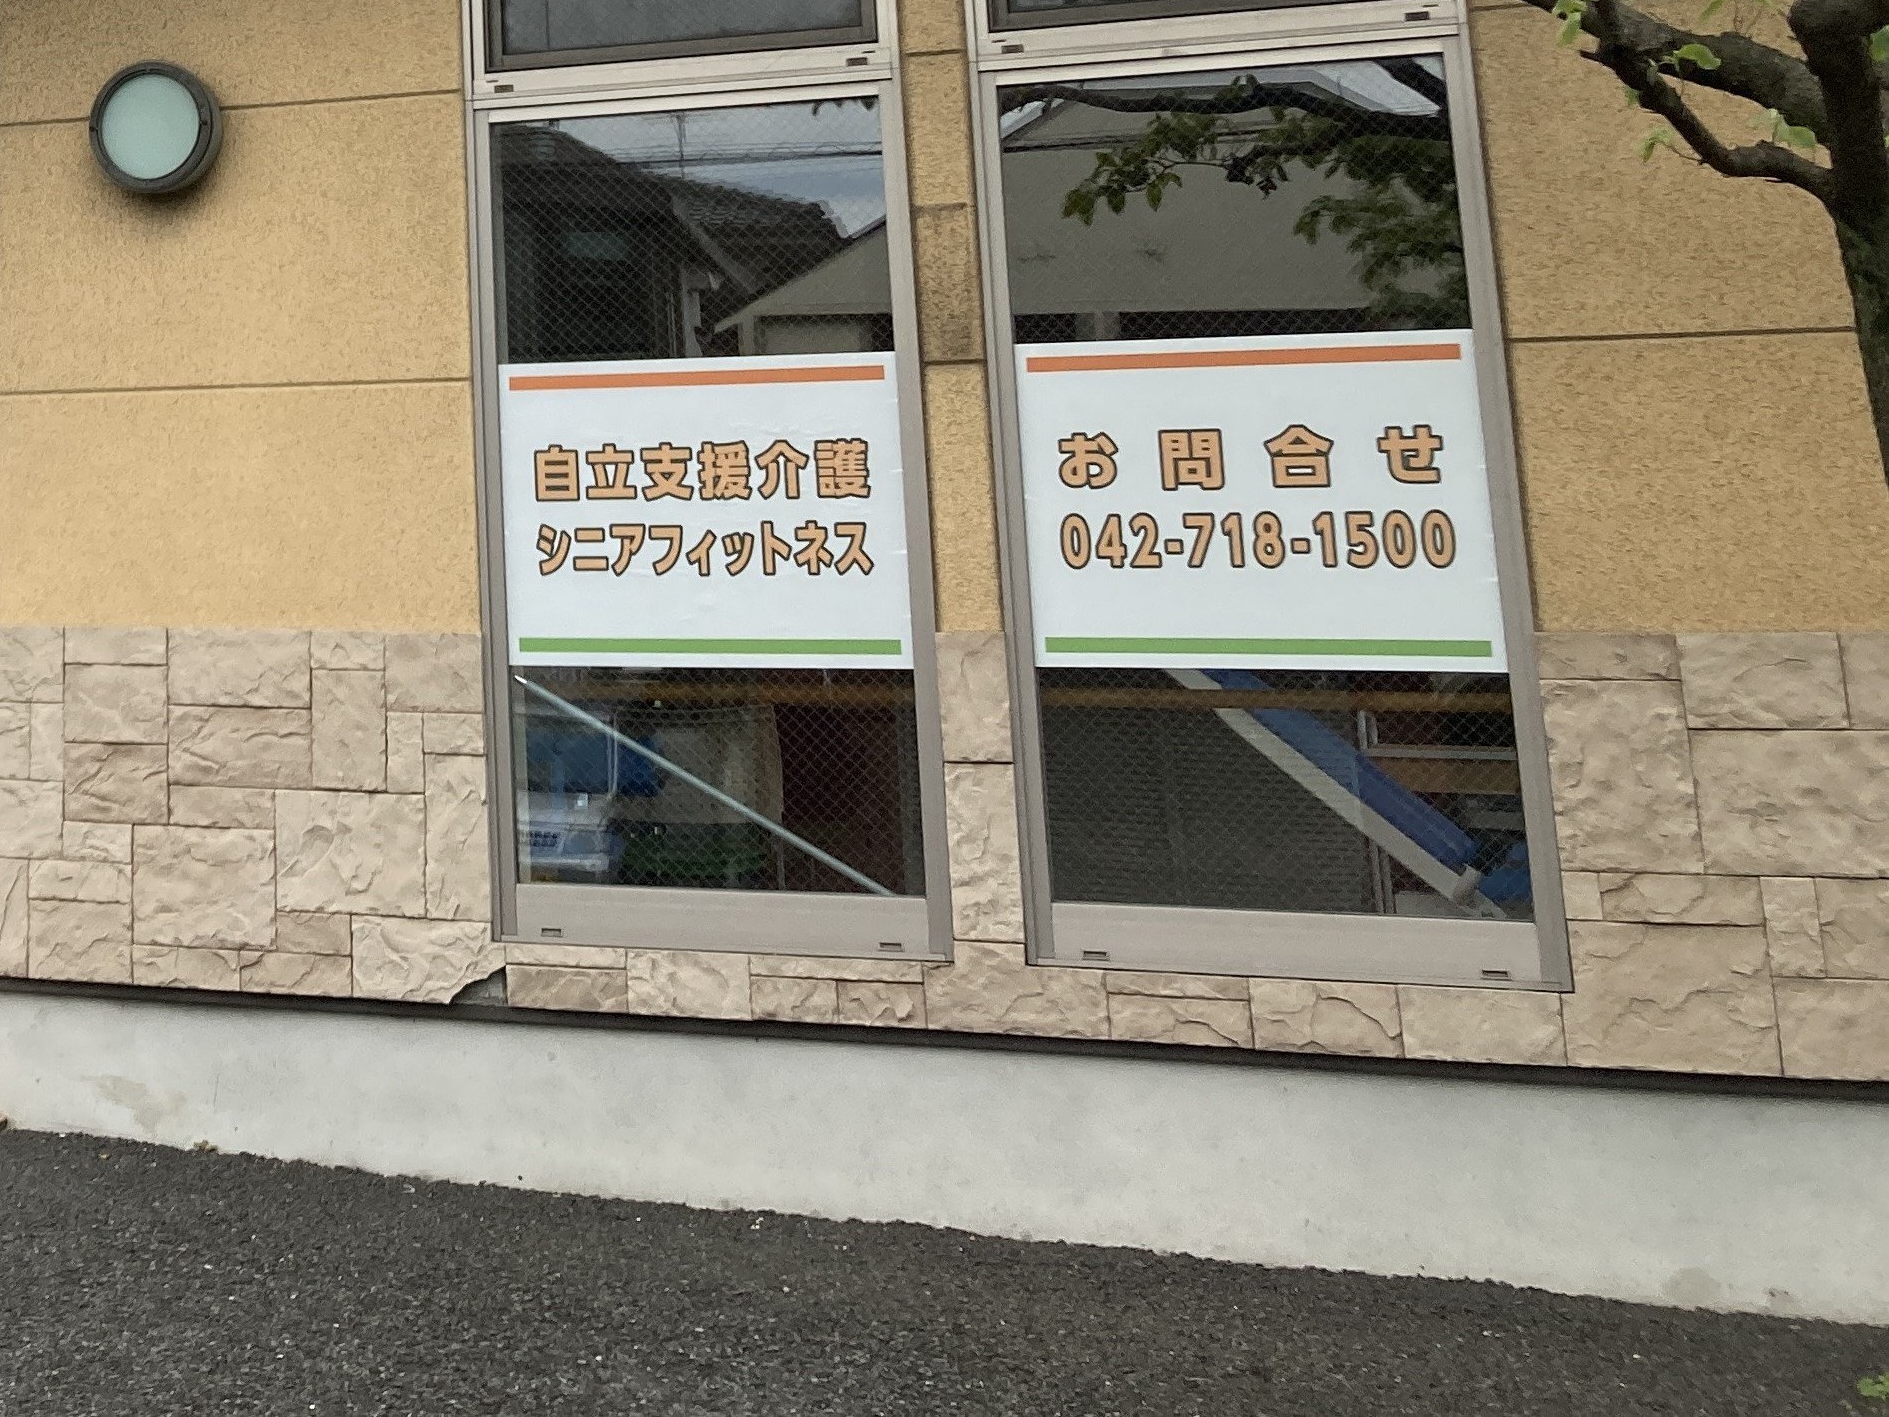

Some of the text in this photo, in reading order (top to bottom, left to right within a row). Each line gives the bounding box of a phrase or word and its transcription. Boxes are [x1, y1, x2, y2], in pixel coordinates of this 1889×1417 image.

[534, 438, 871, 502] 自立支援介護
[1058, 424, 1444, 490] お問合せ
[536, 520, 874, 577] シニアフィットネス
[1060, 509, 1456, 570] 042-718-1500
